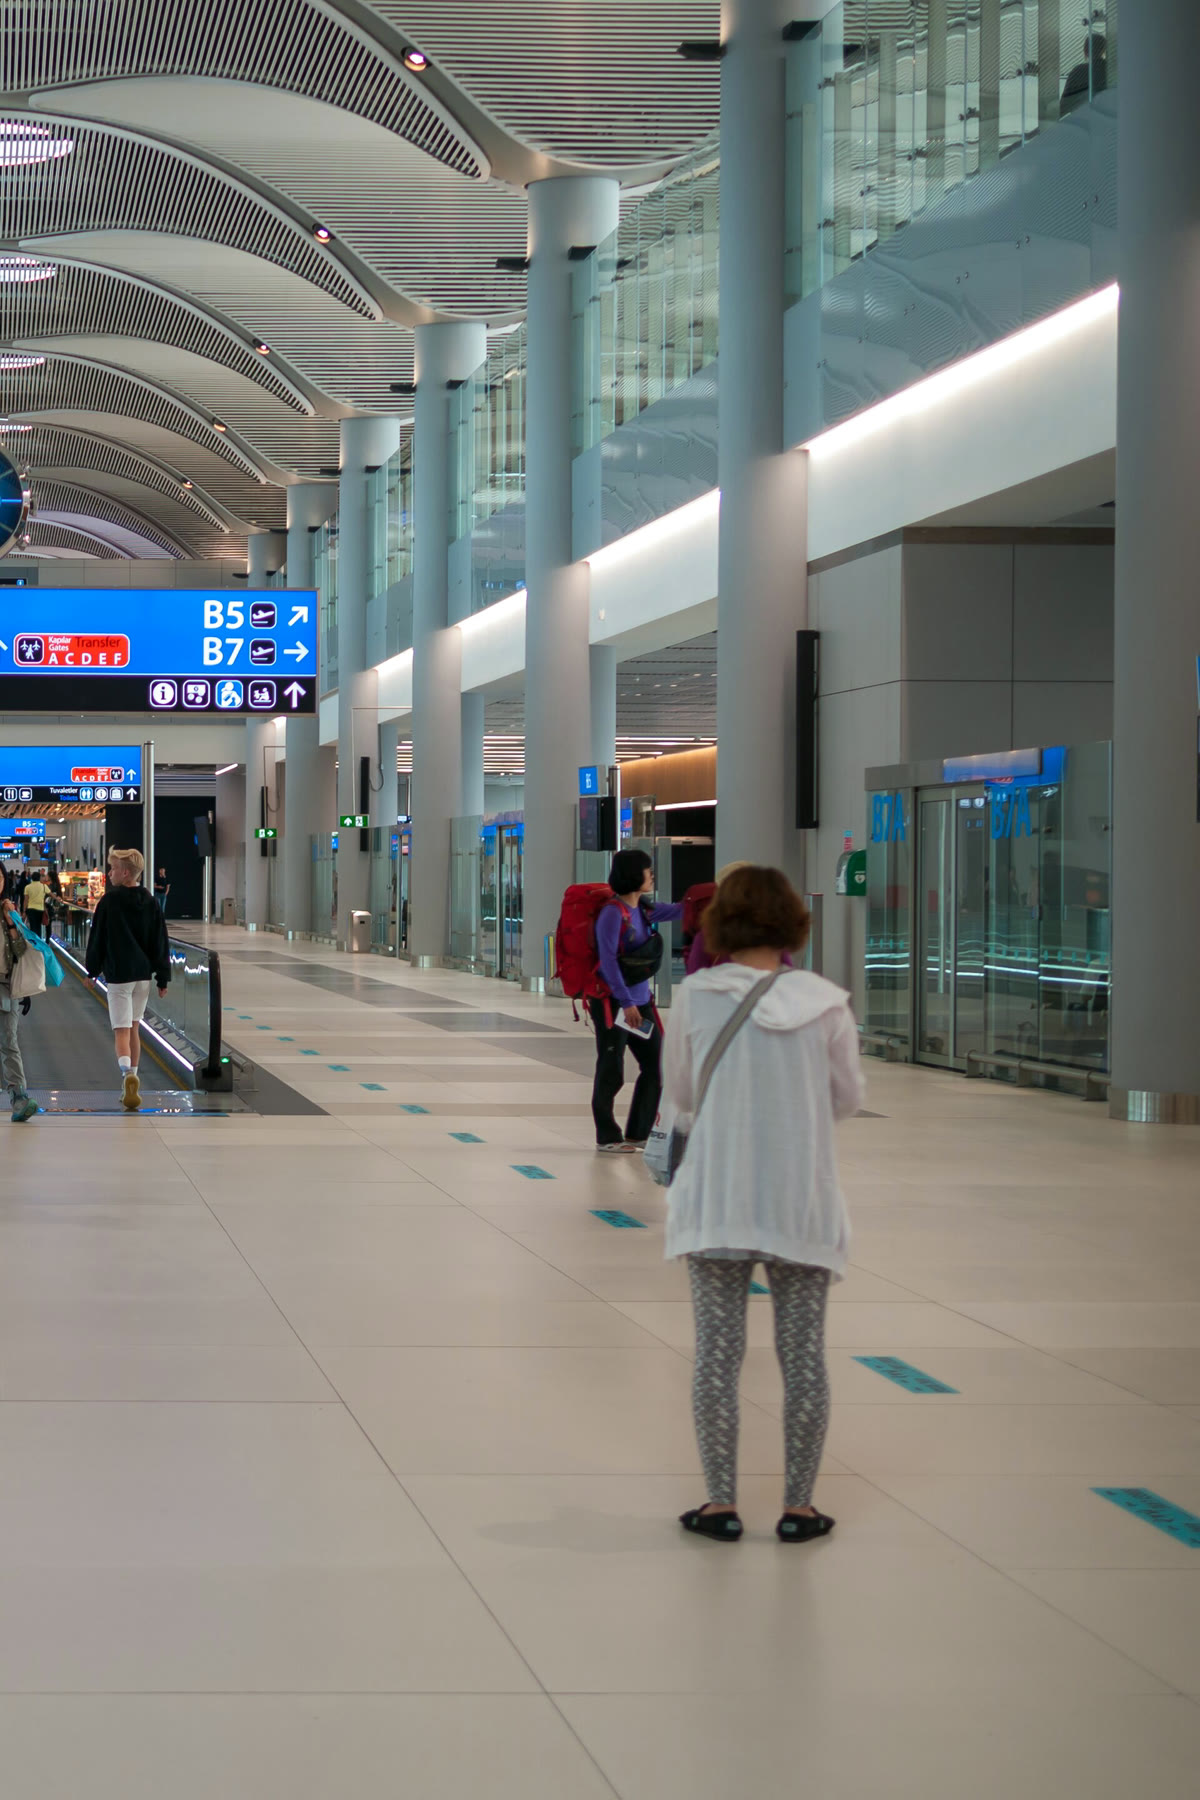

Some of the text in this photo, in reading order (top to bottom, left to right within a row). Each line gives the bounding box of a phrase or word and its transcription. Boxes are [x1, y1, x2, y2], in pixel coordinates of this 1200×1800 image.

[203, 600, 245, 629] B5
[74, 636, 121, 648] Transfer
[203, 636, 244, 665] B7
[48, 652, 122, 665] A C D E F
